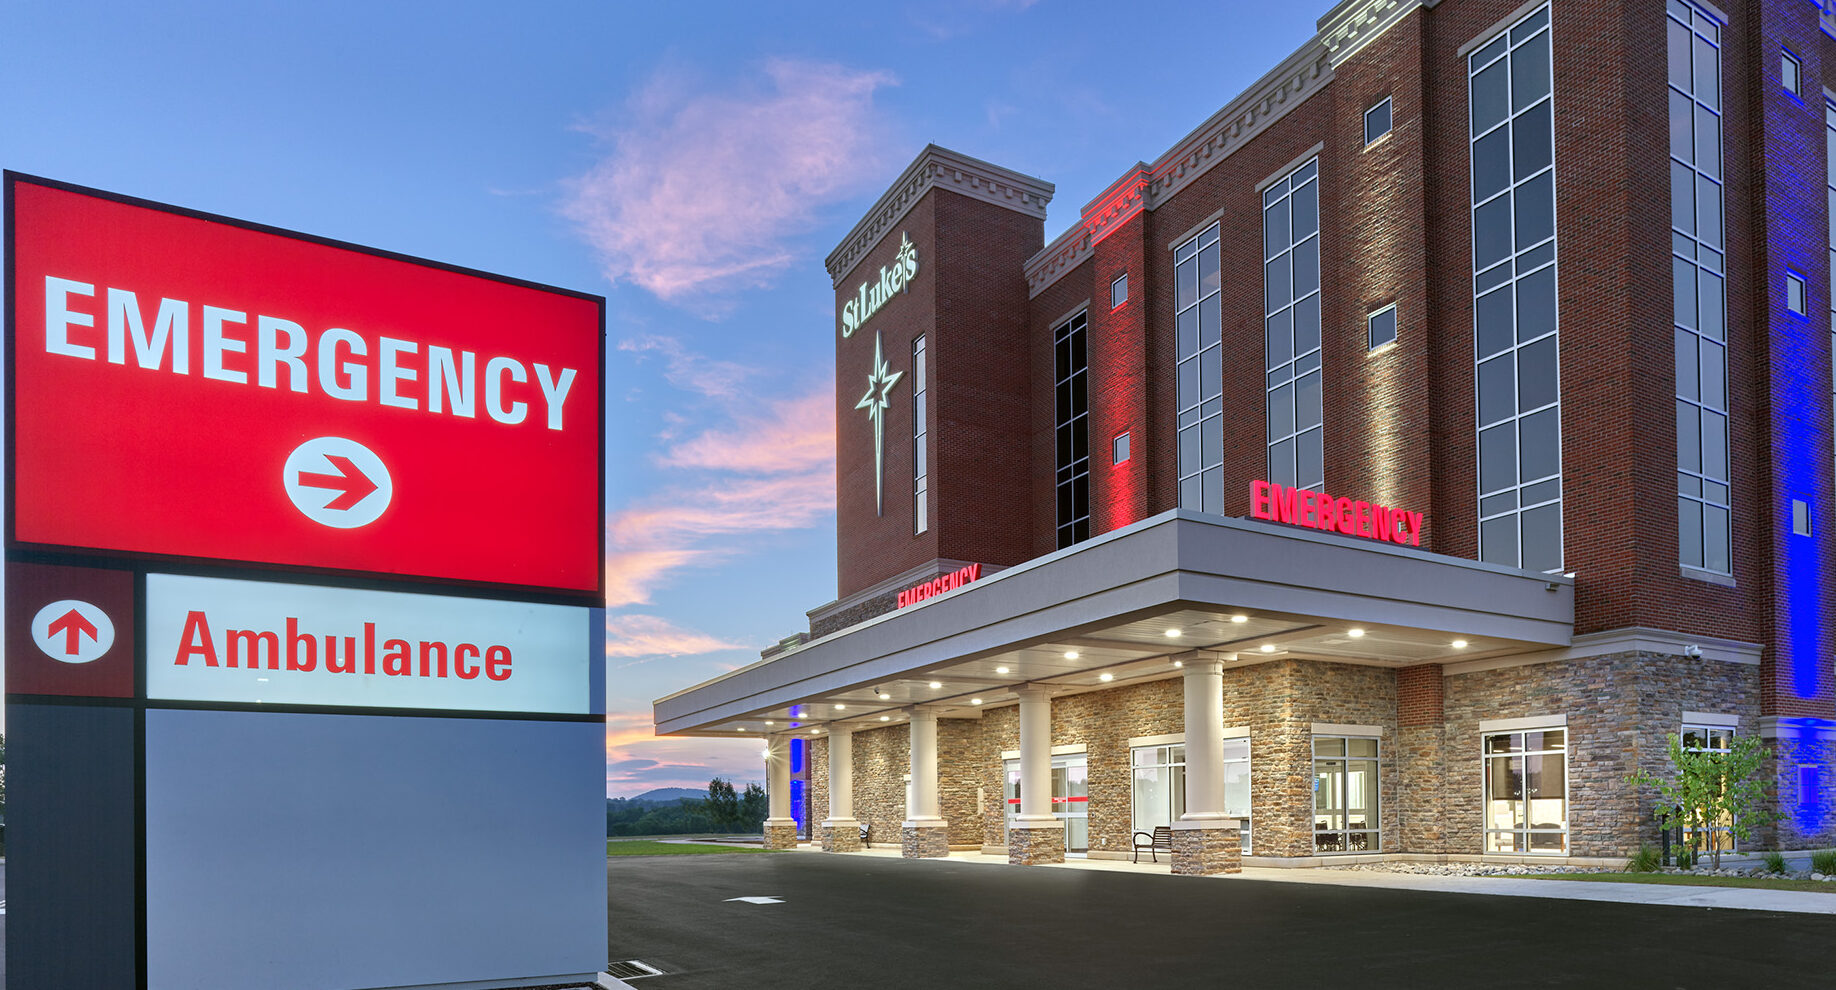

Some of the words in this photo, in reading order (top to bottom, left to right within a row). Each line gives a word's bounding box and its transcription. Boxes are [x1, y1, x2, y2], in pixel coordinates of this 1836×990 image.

[45, 275, 578, 431] EMERGENCY
[1250, 479, 1423, 547] EMERGENCY
[174, 610, 513, 681] Ambulance
